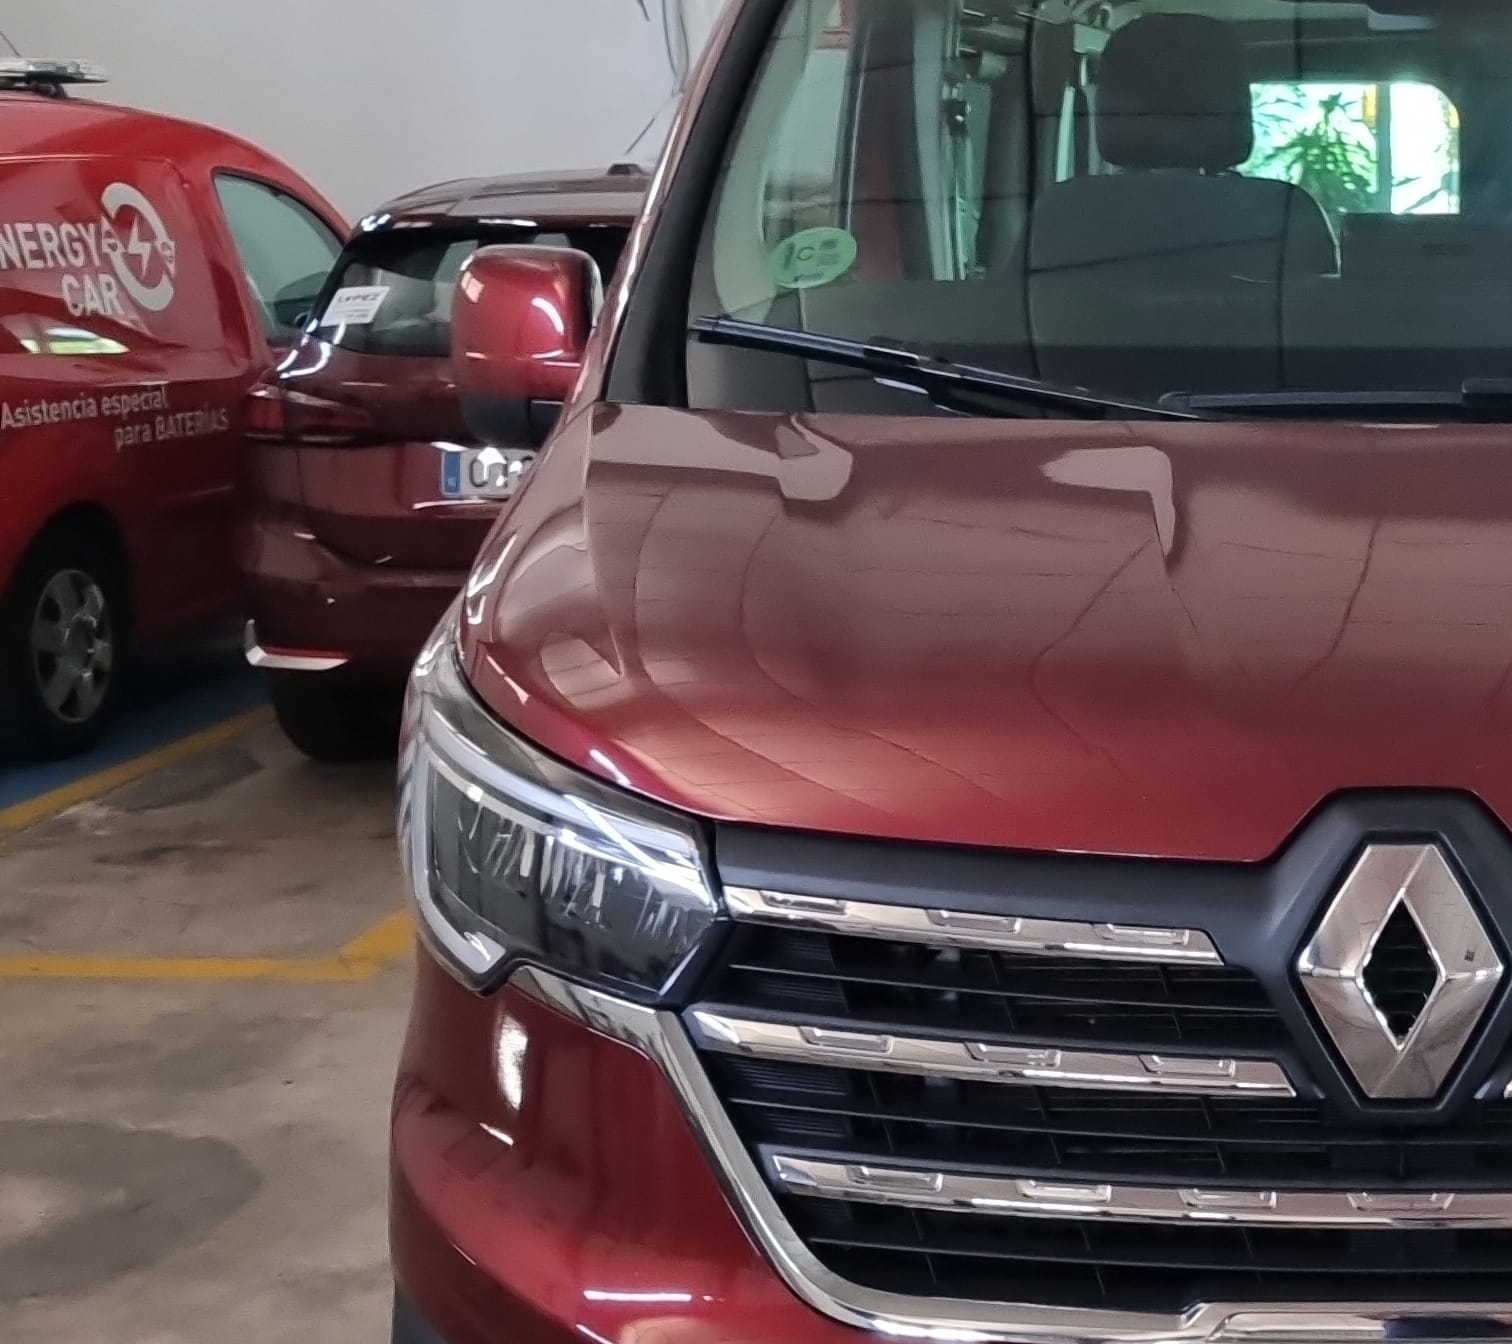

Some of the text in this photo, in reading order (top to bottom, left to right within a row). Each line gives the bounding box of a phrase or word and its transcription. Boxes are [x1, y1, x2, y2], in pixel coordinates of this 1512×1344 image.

[0, 222, 101, 270] NERGY
[61, 273, 124, 317] CAR
[0, 385, 168, 430] Asistencia especial
[114, 422, 152, 452] para
